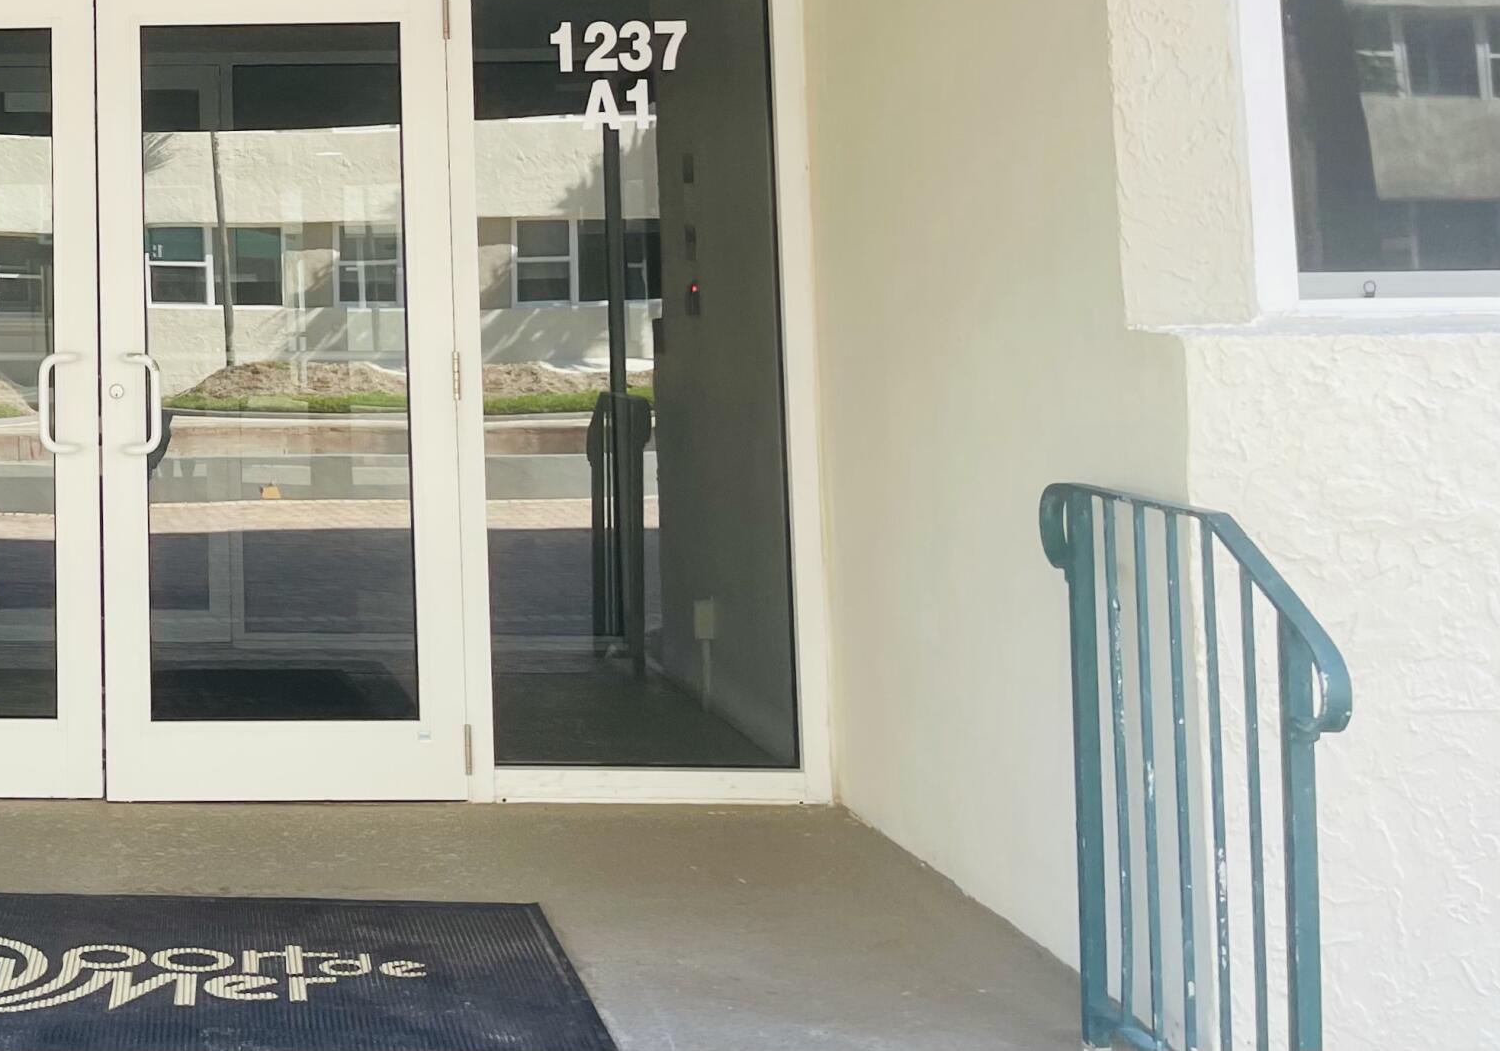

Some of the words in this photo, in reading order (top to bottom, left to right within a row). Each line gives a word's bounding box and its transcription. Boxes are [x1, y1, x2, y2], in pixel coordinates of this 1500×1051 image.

[550, 20, 687, 73] 1237
[582, 78, 650, 130] A1
[319, 953, 427, 977] de
